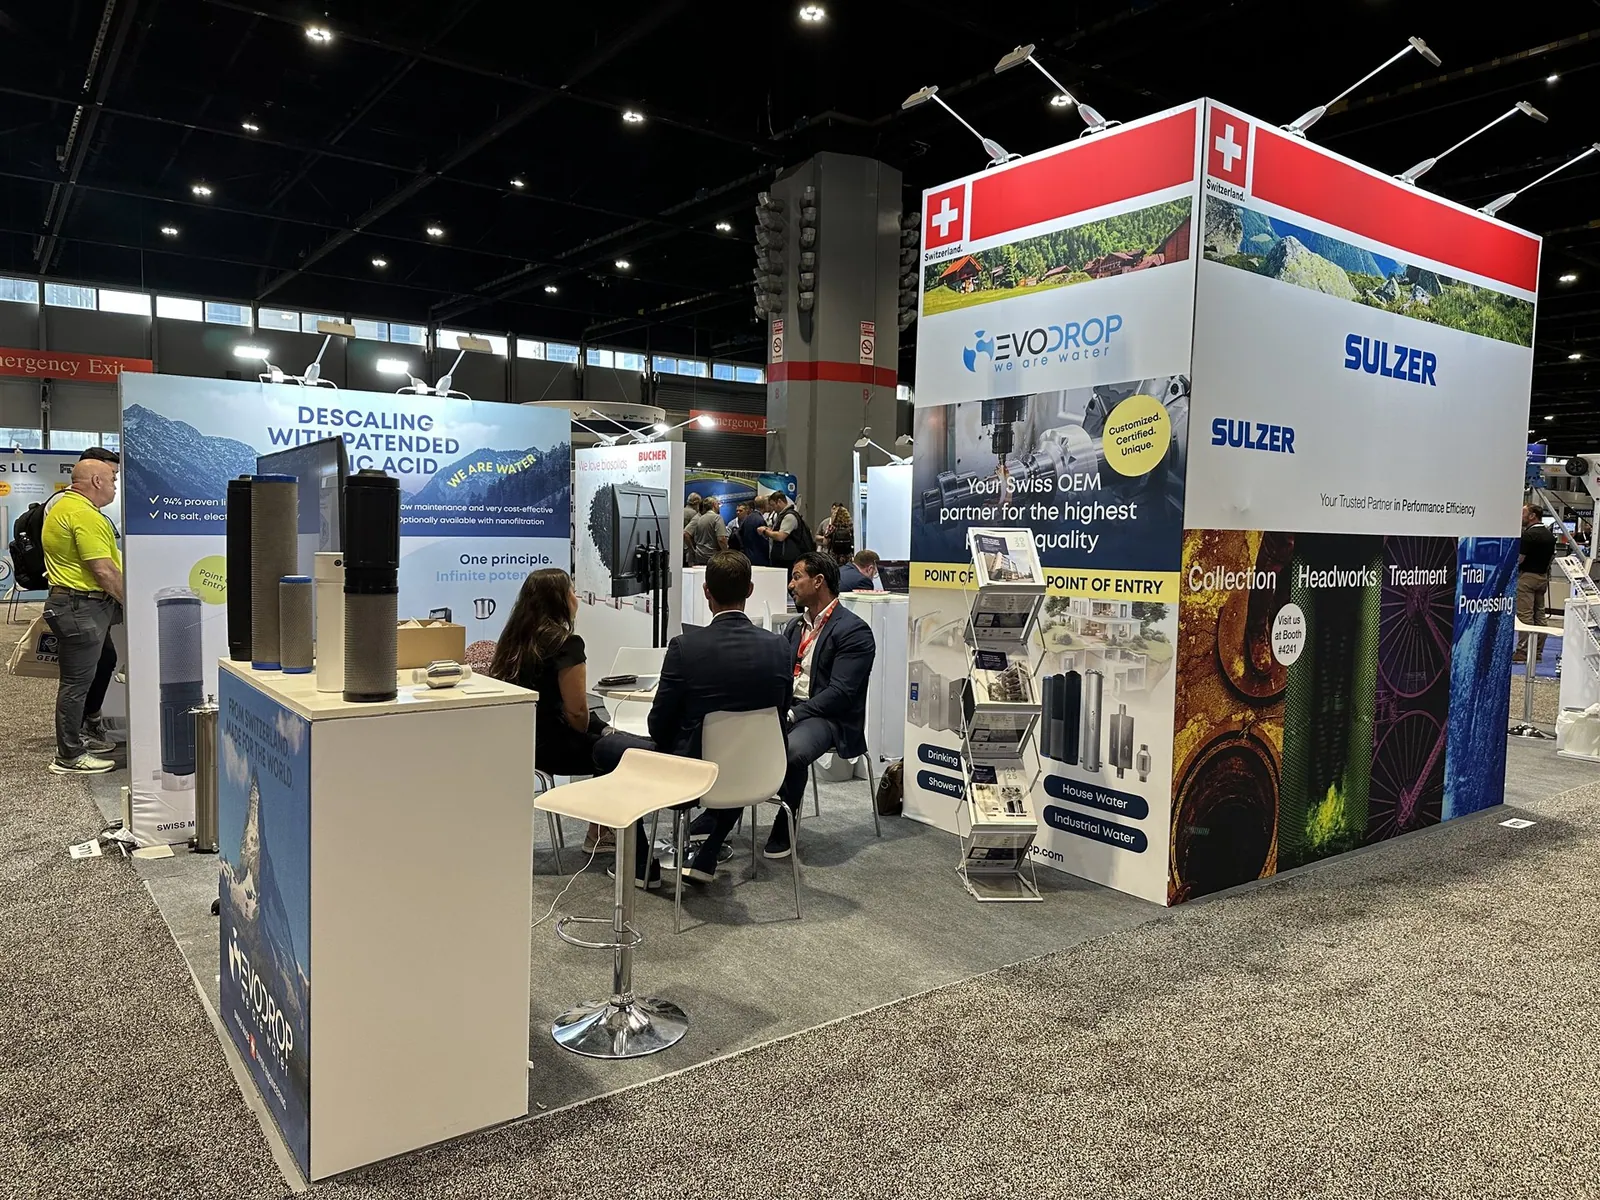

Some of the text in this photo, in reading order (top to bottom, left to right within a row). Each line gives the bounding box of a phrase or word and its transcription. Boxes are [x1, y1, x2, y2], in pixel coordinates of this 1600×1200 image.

[1207, 179, 1245, 202] Switzerland.
[925, 244, 962, 261] Switzerland.
[995, 314, 1122, 361] EVODROP
[0, 356, 80, 376] ergency
[995, 347, 1109, 372] we are water
[1344, 333, 1437, 386] SULZER
[298, 406, 434, 431] DESCALING
[714, 417, 759, 431] mergency
[1109, 412, 1161, 435] Customized.
[343, 432, 460, 454] PATENDED
[1116, 426, 1156, 445] Certified.
[1212, 418, 1295, 454] SULZER
[638, 450, 666, 461] BUCHER
[1121, 442, 1153, 456] Unique.
[12, 463, 37, 473] LLC
[350, 455, 438, 474] IC ACID
[447, 454, 536, 488] WE ARE WATER
[589, 460, 600, 471] love
[601, 459, 627, 470] biosolids
[967, 473, 1101, 495] Your Swiss OEM
[504, 506, 553, 514] cost-effective
[940, 501, 1137, 525] partner for the highest
[1320, 493, 1476, 517] Your Trusted Partner in Performance Efficiency
[180, 512, 202, 521] salt,
[1035, 530, 1099, 553] quality
[460, 554, 553, 566] One principle.
[199, 569, 223, 582] Point
[436, 570, 527, 583] Infinite poten
[925, 570, 974, 583] POINT OF
[1188, 566, 1276, 591] Collection
[1298, 565, 1376, 588] Headworks
[1389, 565, 1447, 586] Treatment
[1461, 564, 1485, 584] Final
[202, 578, 226, 592] Entry
[1046, 575, 1163, 595] POINT OF ENTRY
[1458, 593, 1513, 614] Processing
[1278, 614, 1300, 625] Visit us
[1275, 630, 1302, 640] at Booth
[1278, 644, 1297, 654] #4241
[229, 698, 289, 760] FROM SWITZERLAND.
[226, 717, 294, 791] MADE FOR THE WORLD.
[928, 750, 958, 767] Drinking
[929, 777, 956, 791] Shower
[1062, 784, 1128, 809] House Water
[157, 822, 185, 831] SWISS
[1054, 812, 1135, 844] Industrial Water
[1028, 844, 1064, 862] op.com
[241, 951, 293, 1059] EVODROP
[252, 1008, 263, 1033] are
[266, 1032, 288, 1076] water
